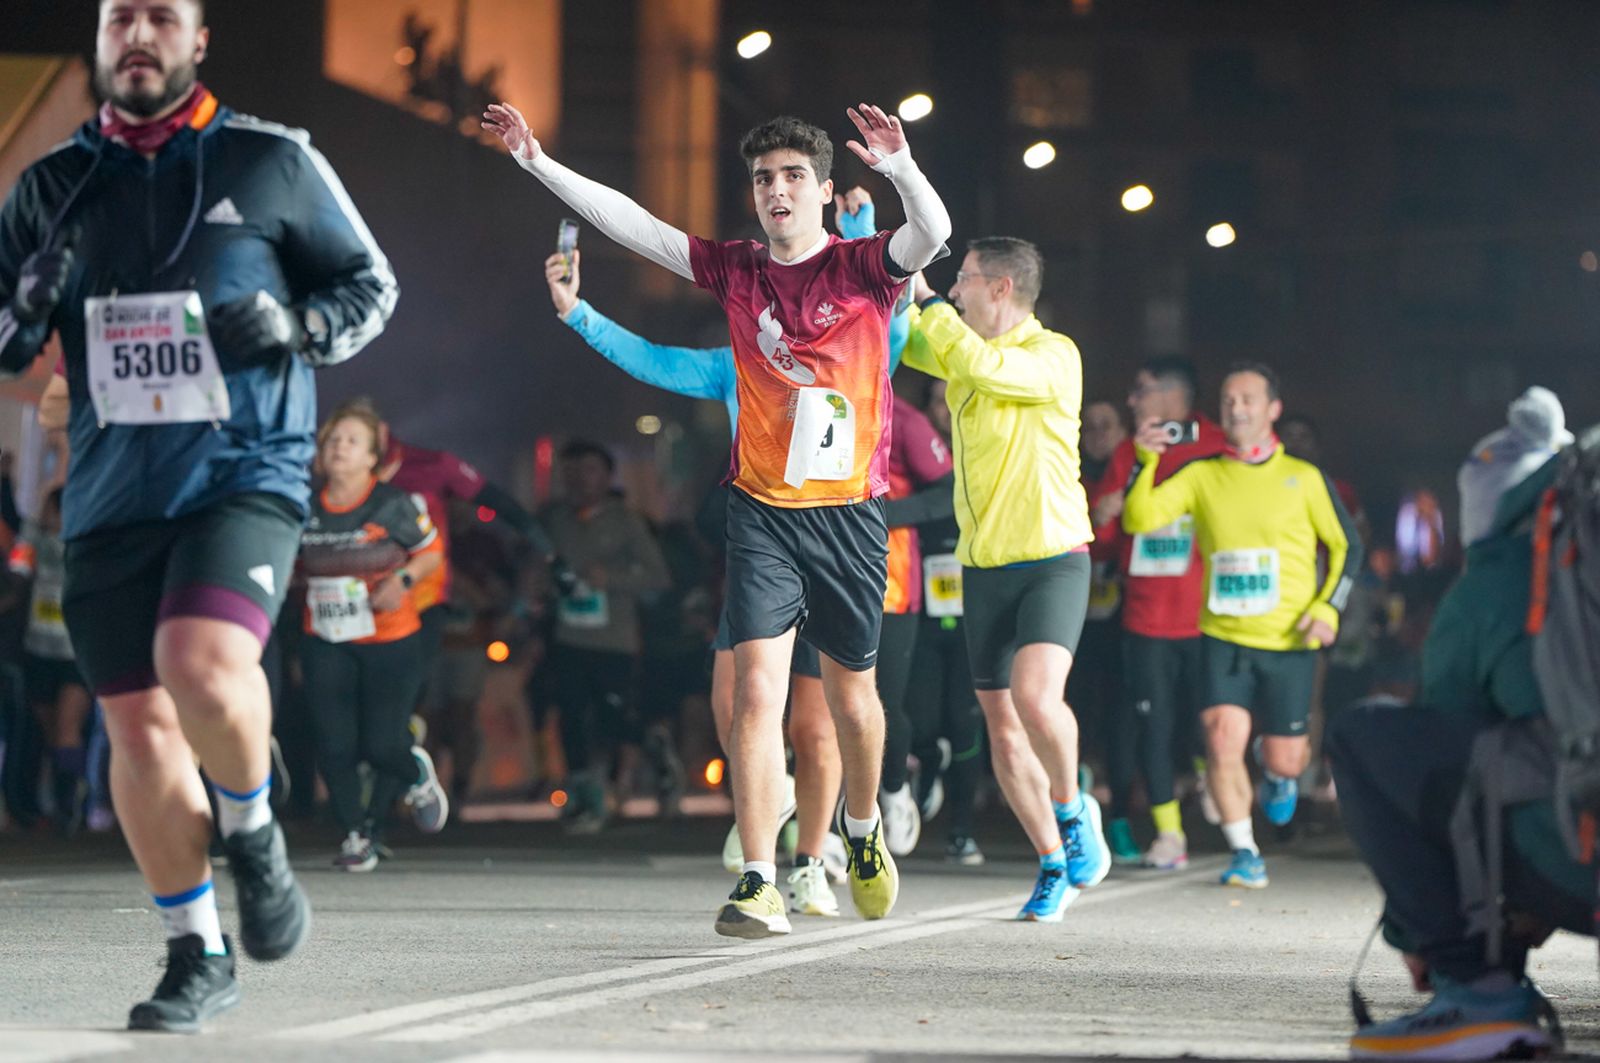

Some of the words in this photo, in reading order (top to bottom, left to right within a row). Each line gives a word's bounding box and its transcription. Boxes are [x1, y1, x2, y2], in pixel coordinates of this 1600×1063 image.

[105, 327, 127, 340] SAN
[113, 341, 202, 379] 5306
[772, 348, 794, 370] 43
